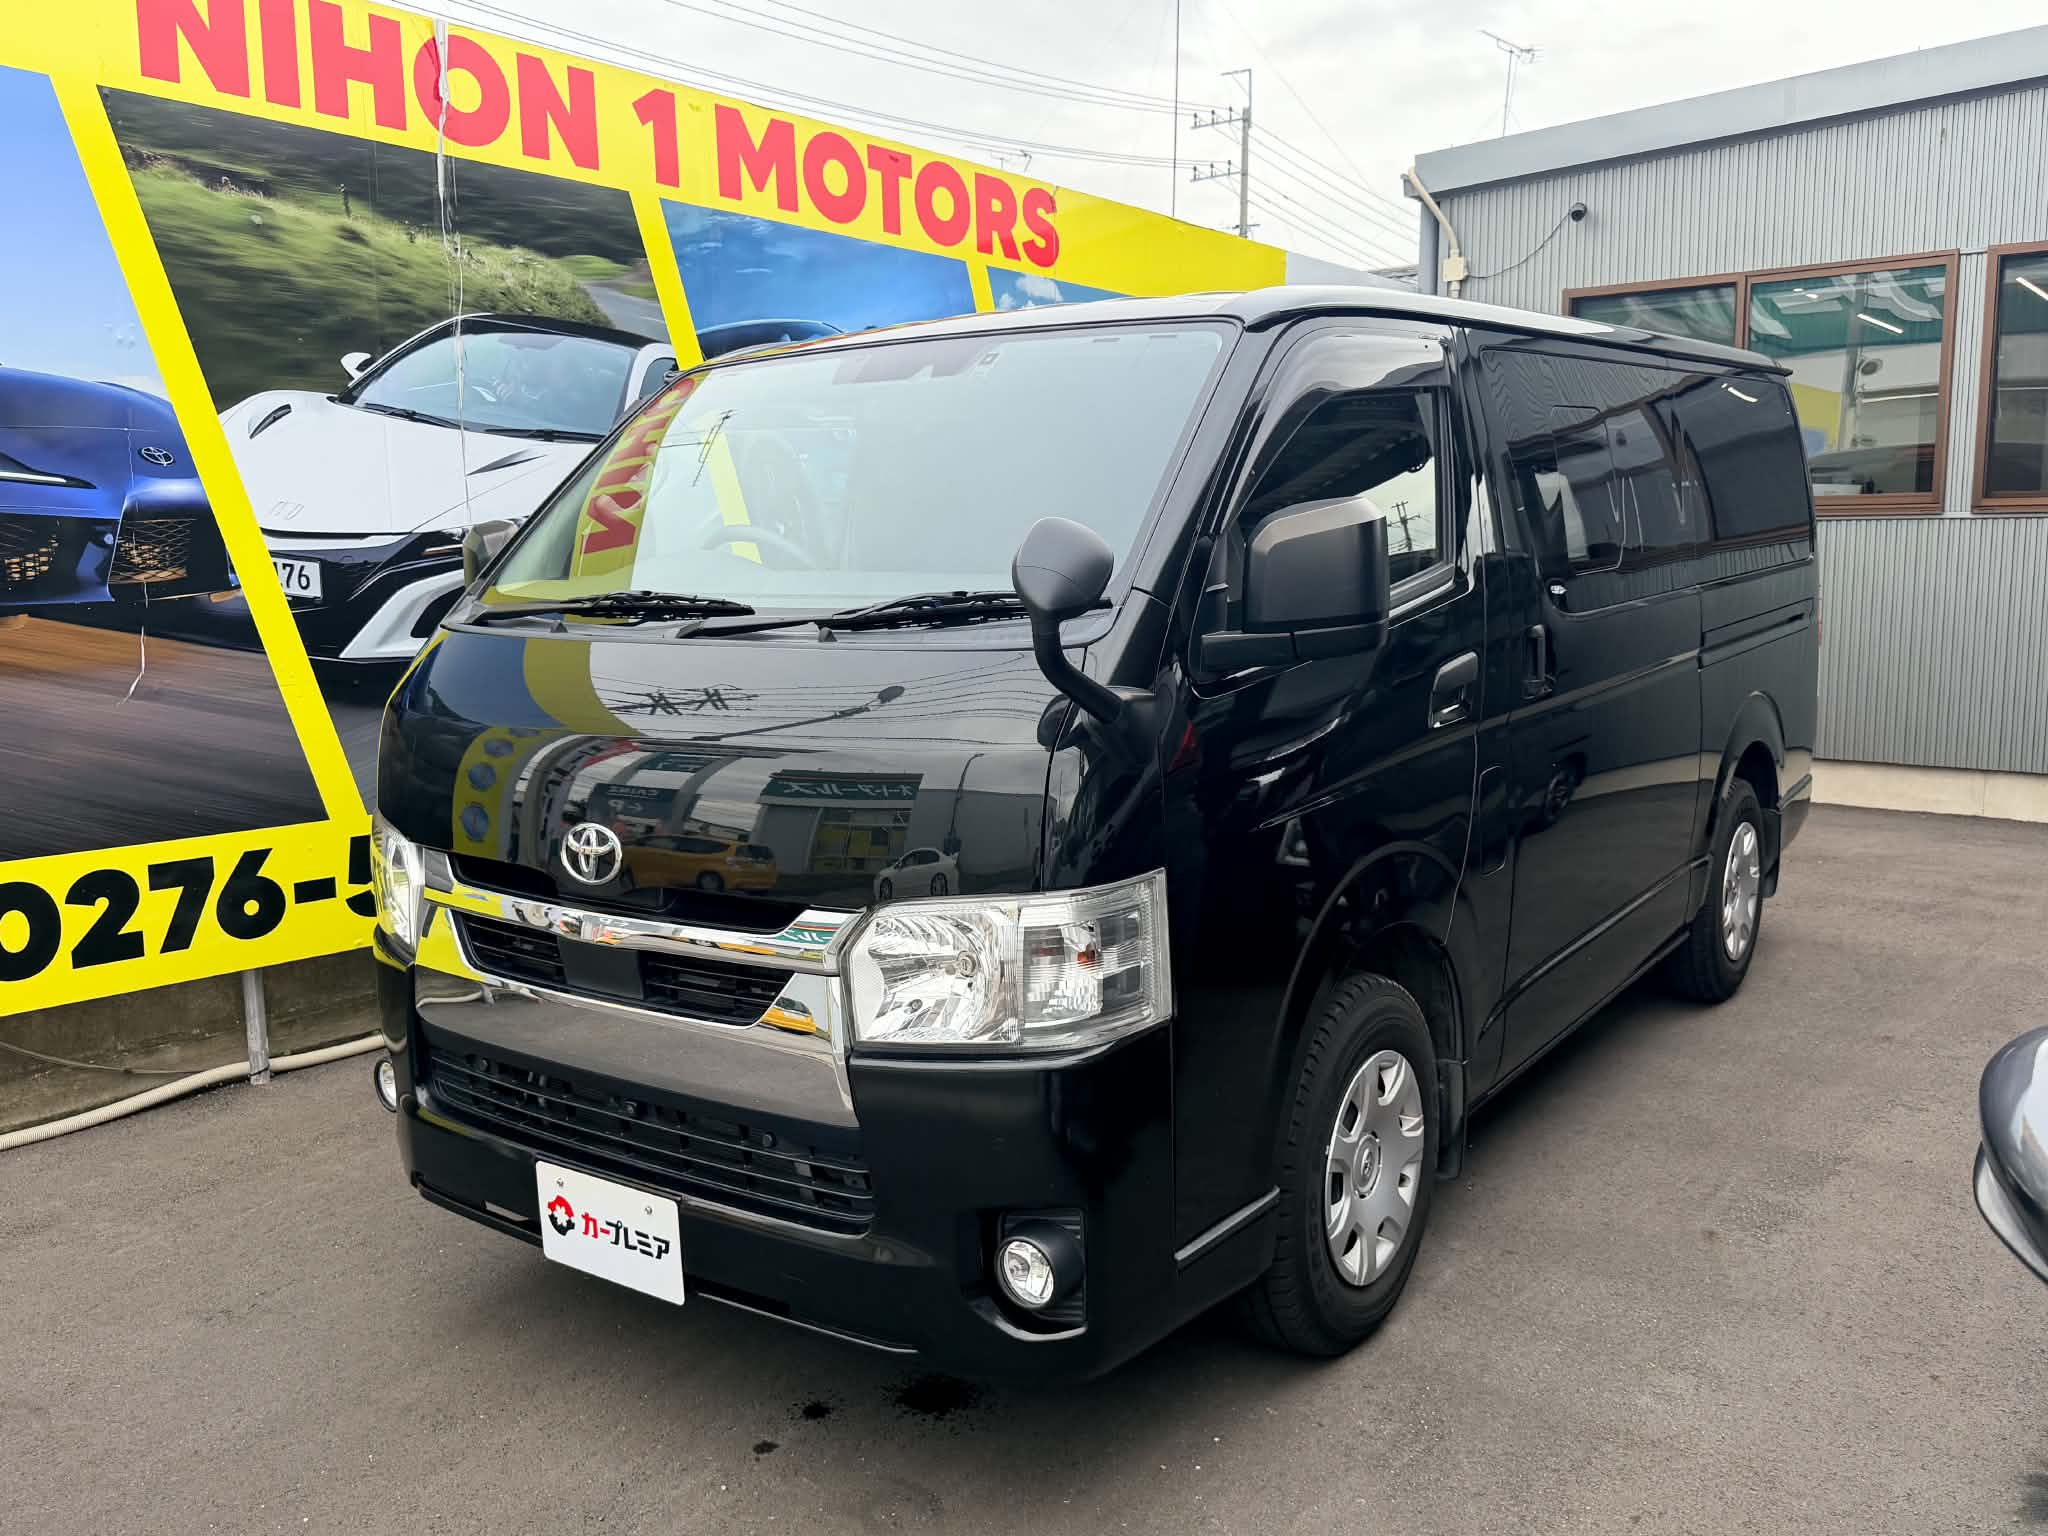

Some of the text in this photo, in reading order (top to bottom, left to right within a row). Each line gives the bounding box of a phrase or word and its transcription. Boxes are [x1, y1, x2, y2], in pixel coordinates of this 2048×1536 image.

[136, 0, 1060, 267] NIHON 1 MOTORS
[273, 562, 310, 590] 76
[581, 1211, 670, 1260] カープレミア
